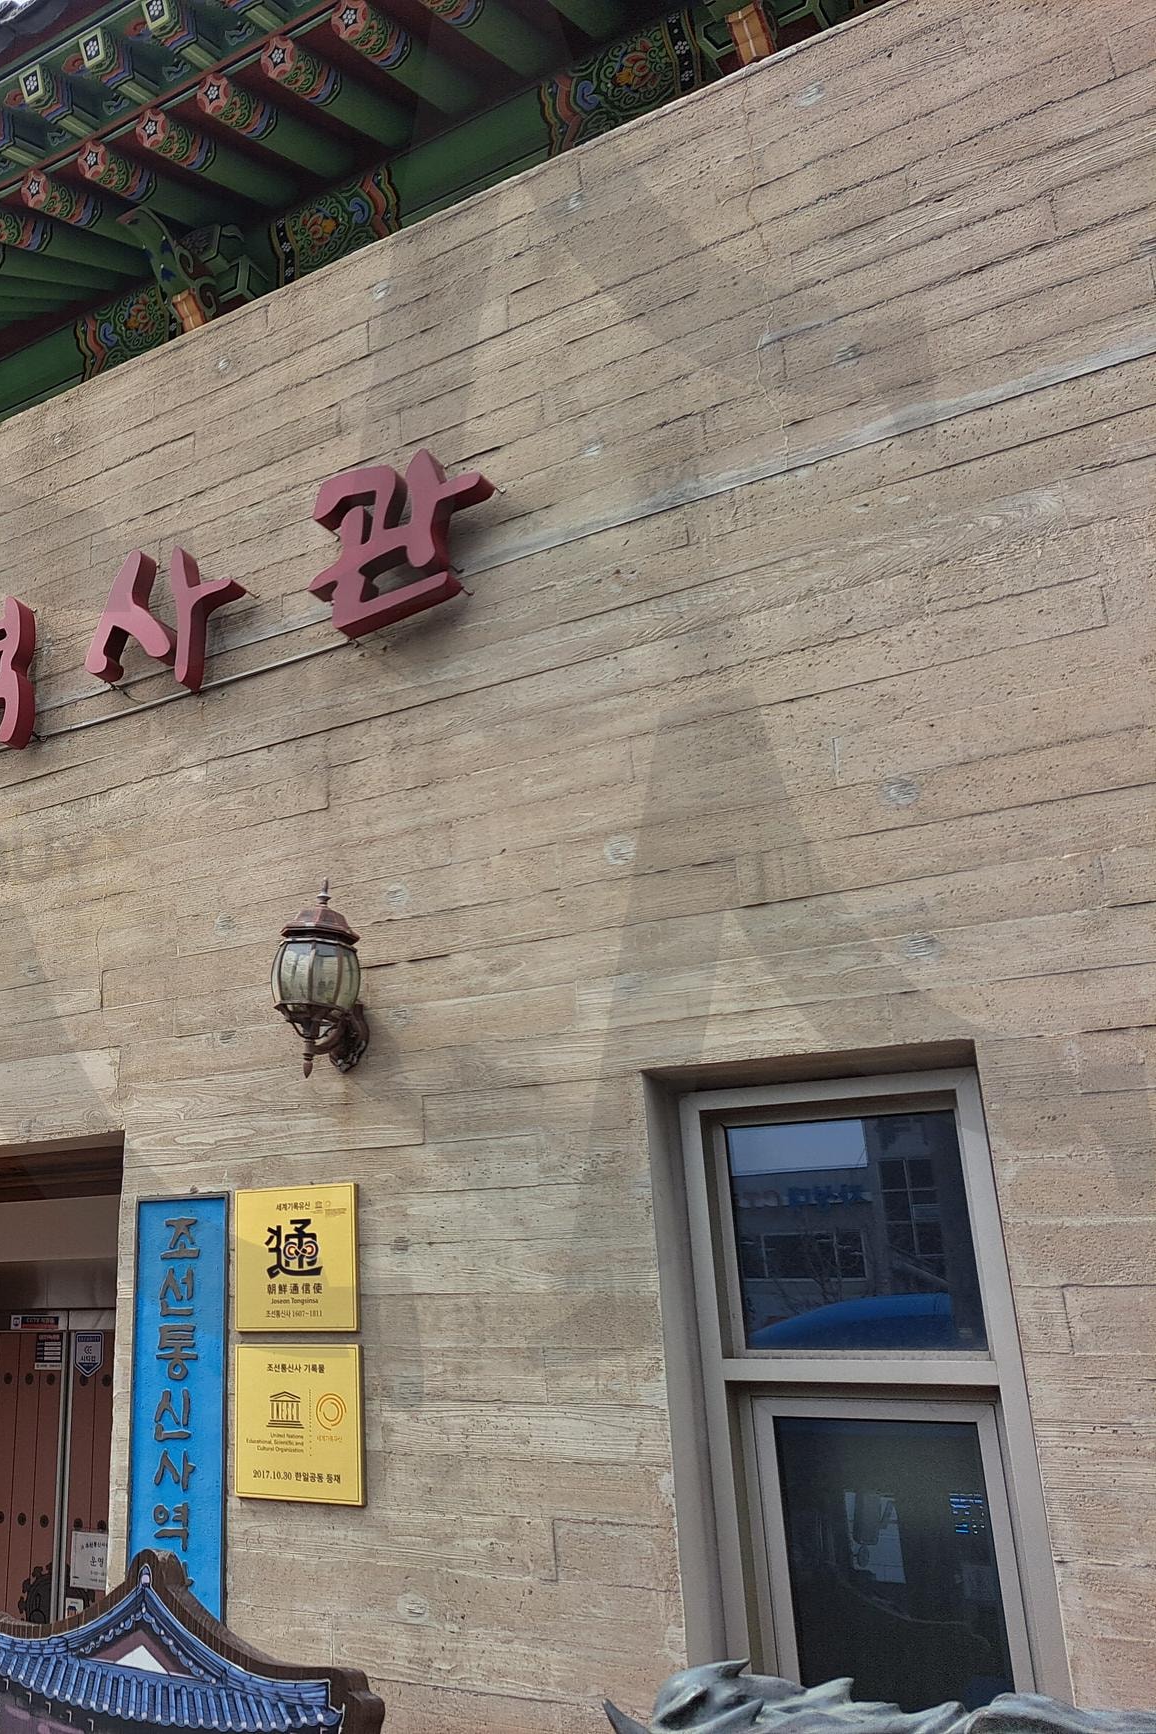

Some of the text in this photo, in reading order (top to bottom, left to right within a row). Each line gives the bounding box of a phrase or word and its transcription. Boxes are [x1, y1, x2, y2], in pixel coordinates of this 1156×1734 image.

[267, 1283, 323, 1296] 朝鮮通信使
[270, 1297, 319, 1306] Joseon Tongsinsa
[266, 1310, 291, 1319] 조선통신사
[267, 1363, 325, 1374] 조선통신사 기록물
[253, 1469, 292, 1481] 2017.10.30
[295, 1472, 324, 1483] 한일공동
